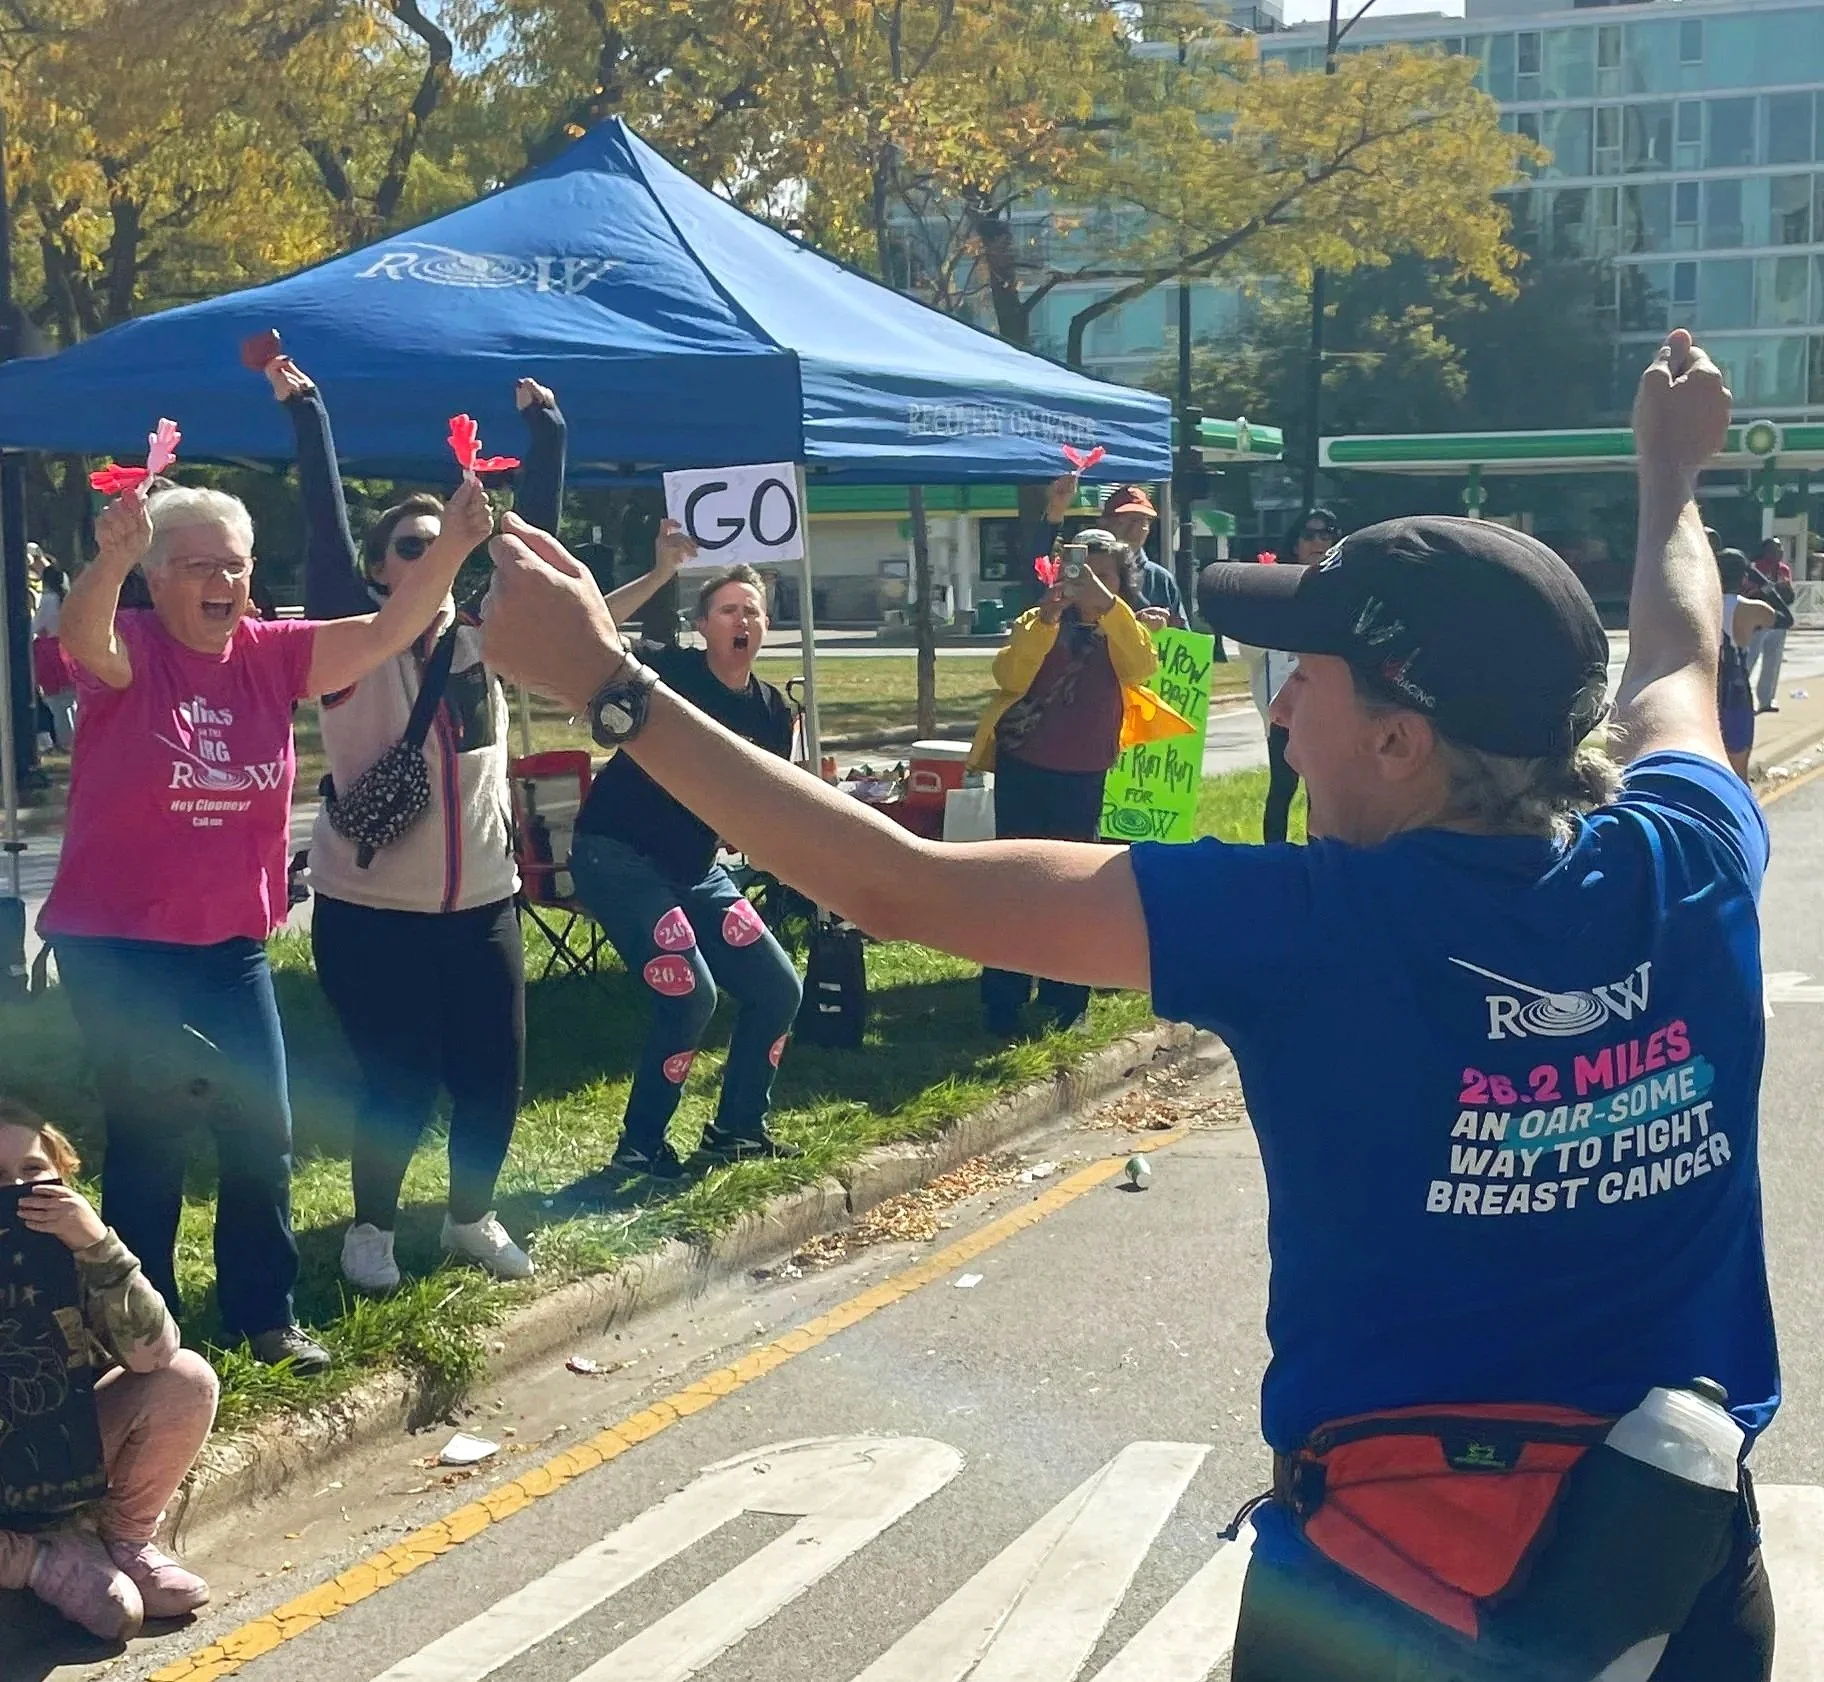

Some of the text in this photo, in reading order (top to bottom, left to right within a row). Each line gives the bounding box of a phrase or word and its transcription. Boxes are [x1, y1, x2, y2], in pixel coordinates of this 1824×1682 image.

[684, 478, 798, 550] GO
[168, 760, 287, 791] ROW
[170, 799, 251, 813] Hey Clooney!
[1125, 788, 1153, 804] FOR
[192, 817, 209, 827] Call
[1102, 801, 1179, 839] ROW
[1485, 961, 1652, 1040] ROW
[1459, 1019, 1691, 1105] 26.2 MILES
[1450, 1066, 1697, 1141] AN OAR-SOME
[1450, 1101, 1713, 1178] WAY TO FIGHT
[1426, 1131, 1732, 1216] BREAST CANCER
